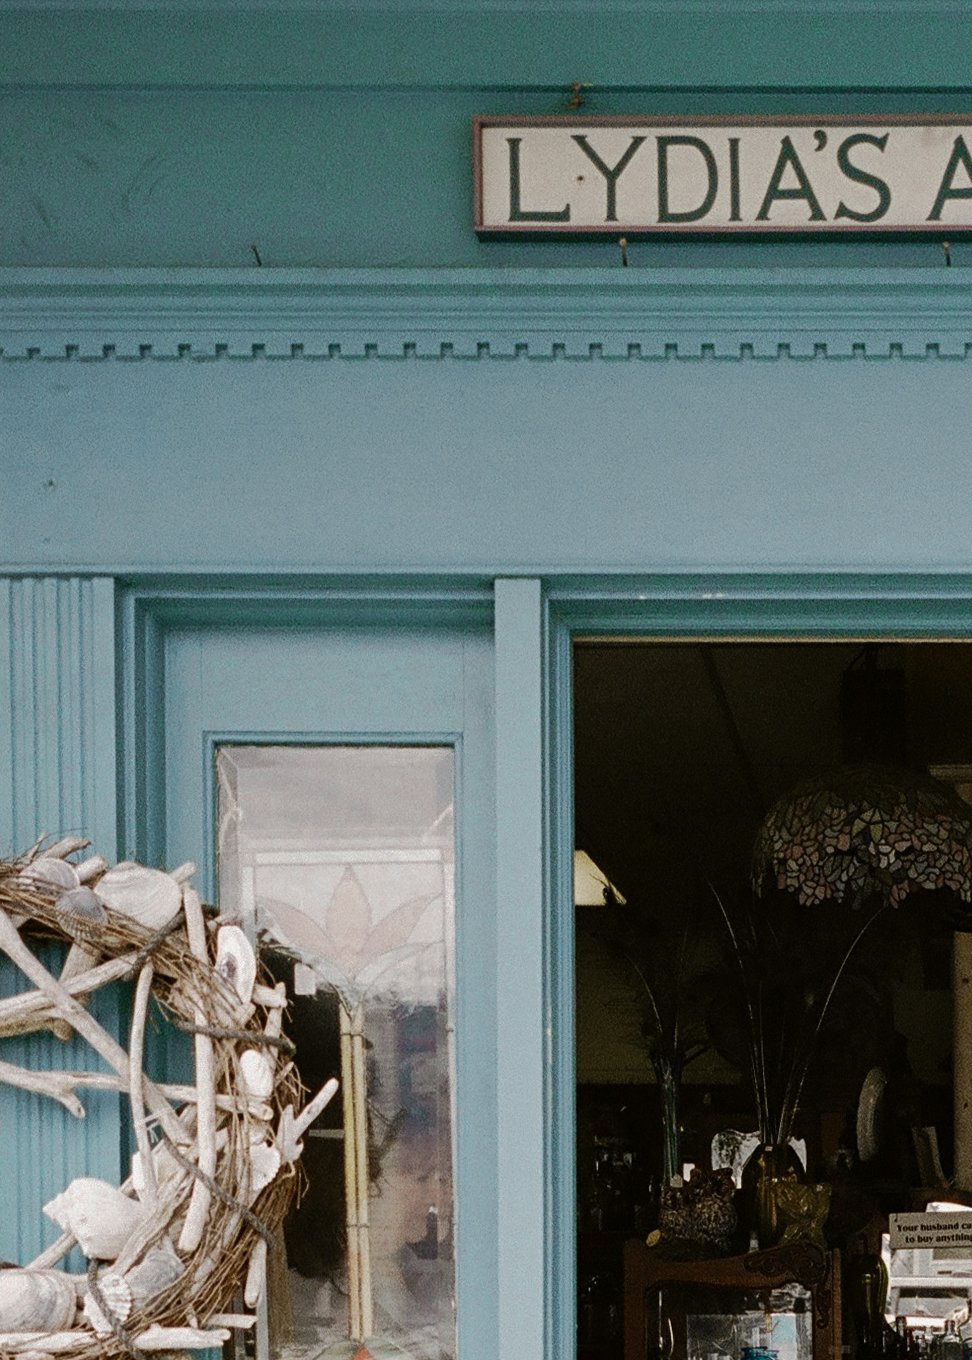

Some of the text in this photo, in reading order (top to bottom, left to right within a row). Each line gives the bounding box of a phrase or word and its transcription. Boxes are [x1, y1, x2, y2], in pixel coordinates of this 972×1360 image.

[506, 131, 893, 223] LYDIA'S
[920, 1222, 959, 1231] husband
[917, 1235, 934, 1245] buy
